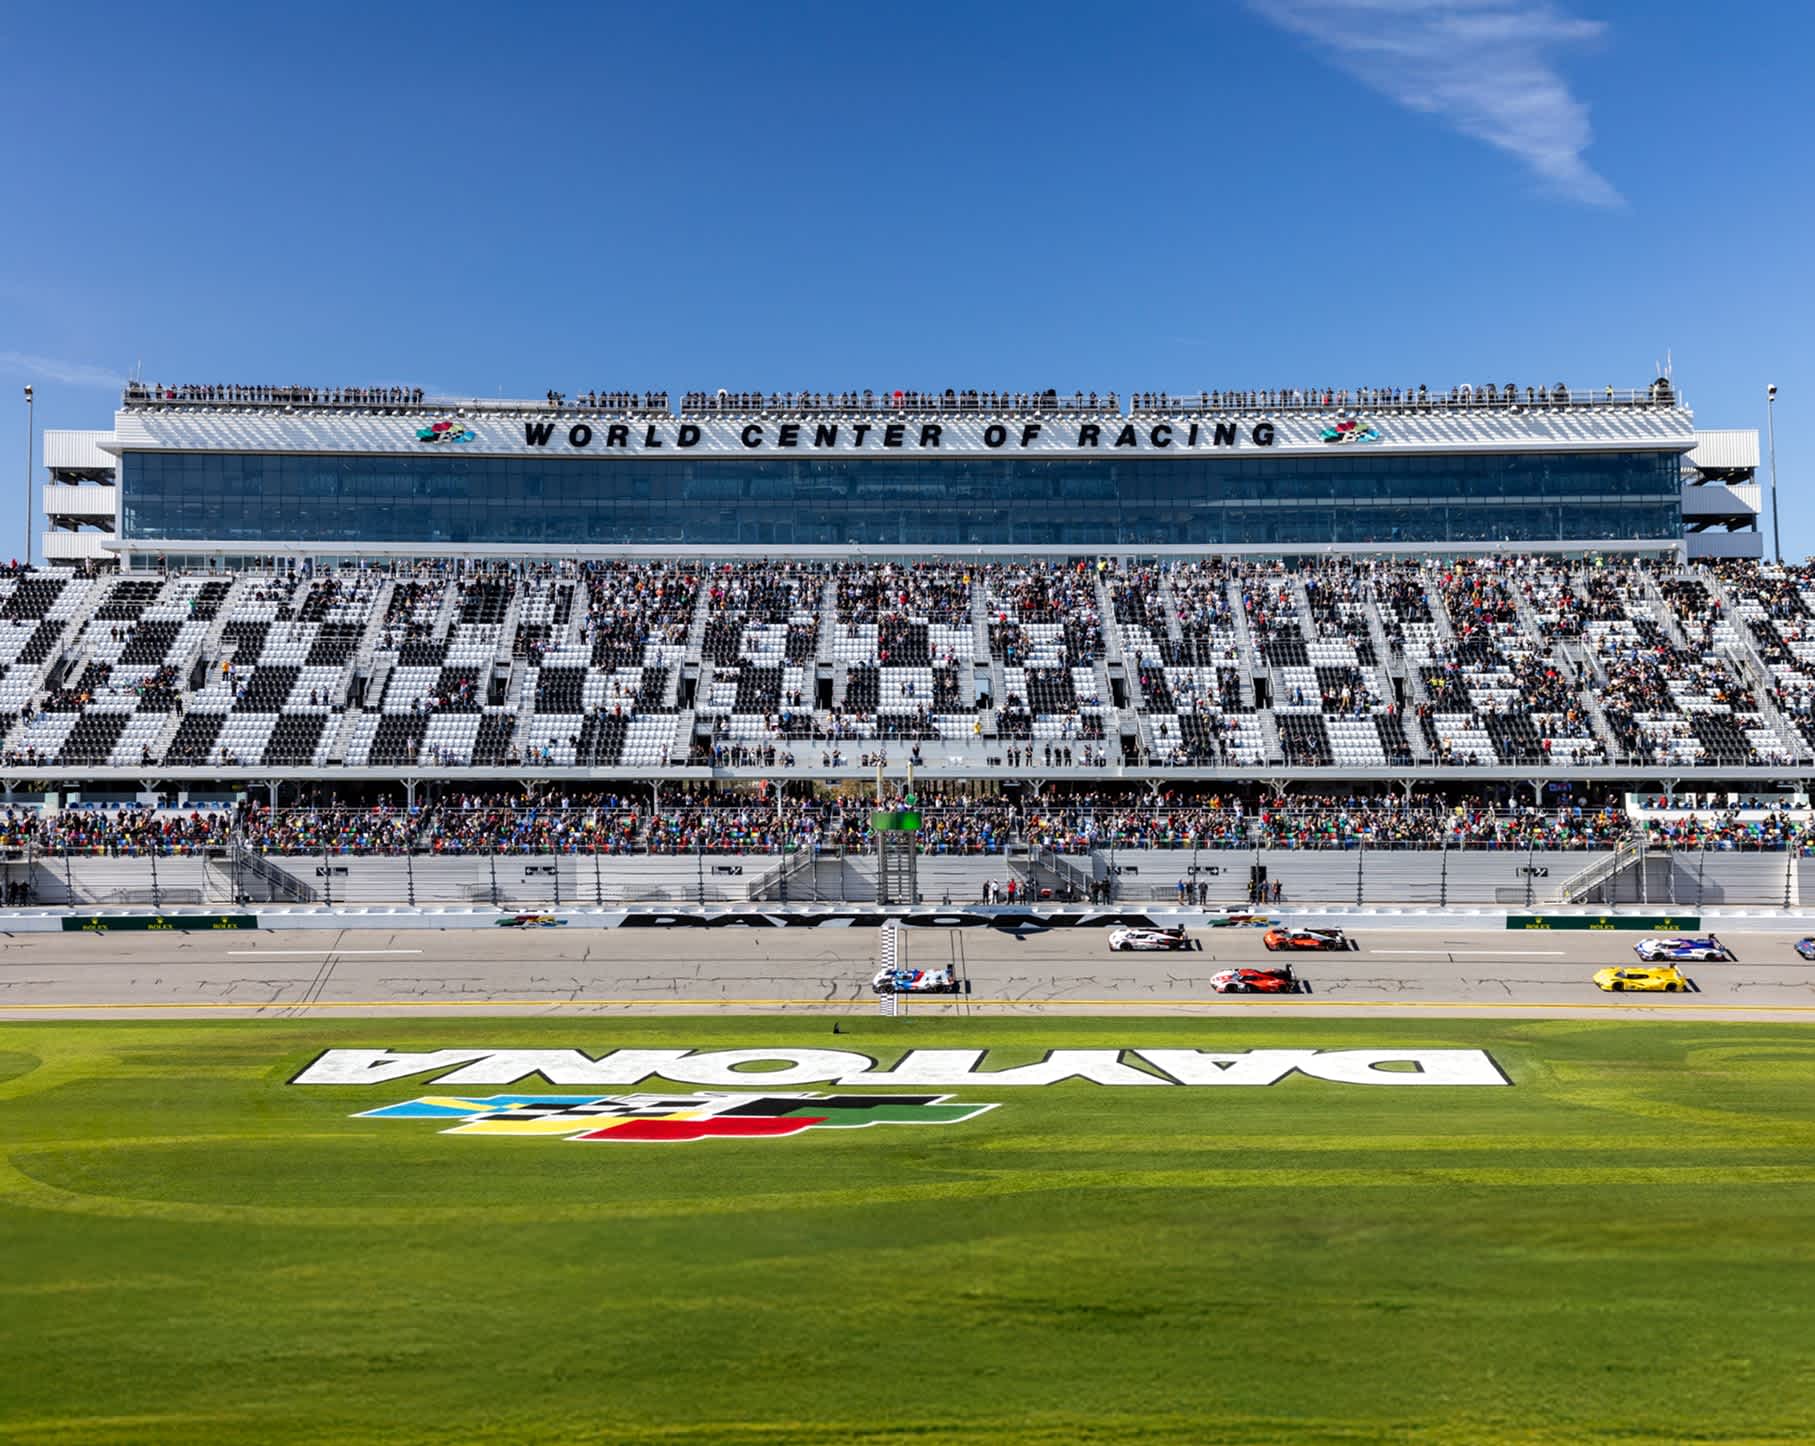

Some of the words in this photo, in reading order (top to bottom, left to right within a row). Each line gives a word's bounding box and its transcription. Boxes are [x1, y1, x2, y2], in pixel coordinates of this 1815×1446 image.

[525, 423, 701, 448] WORLD
[741, 423, 942, 448] CENTER
[984, 423, 1041, 448] OF
[1078, 423, 1275, 448] RACING
[618, 913, 1160, 928] DAYTONA
[286, 1048, 1515, 1086] DAYTONA
